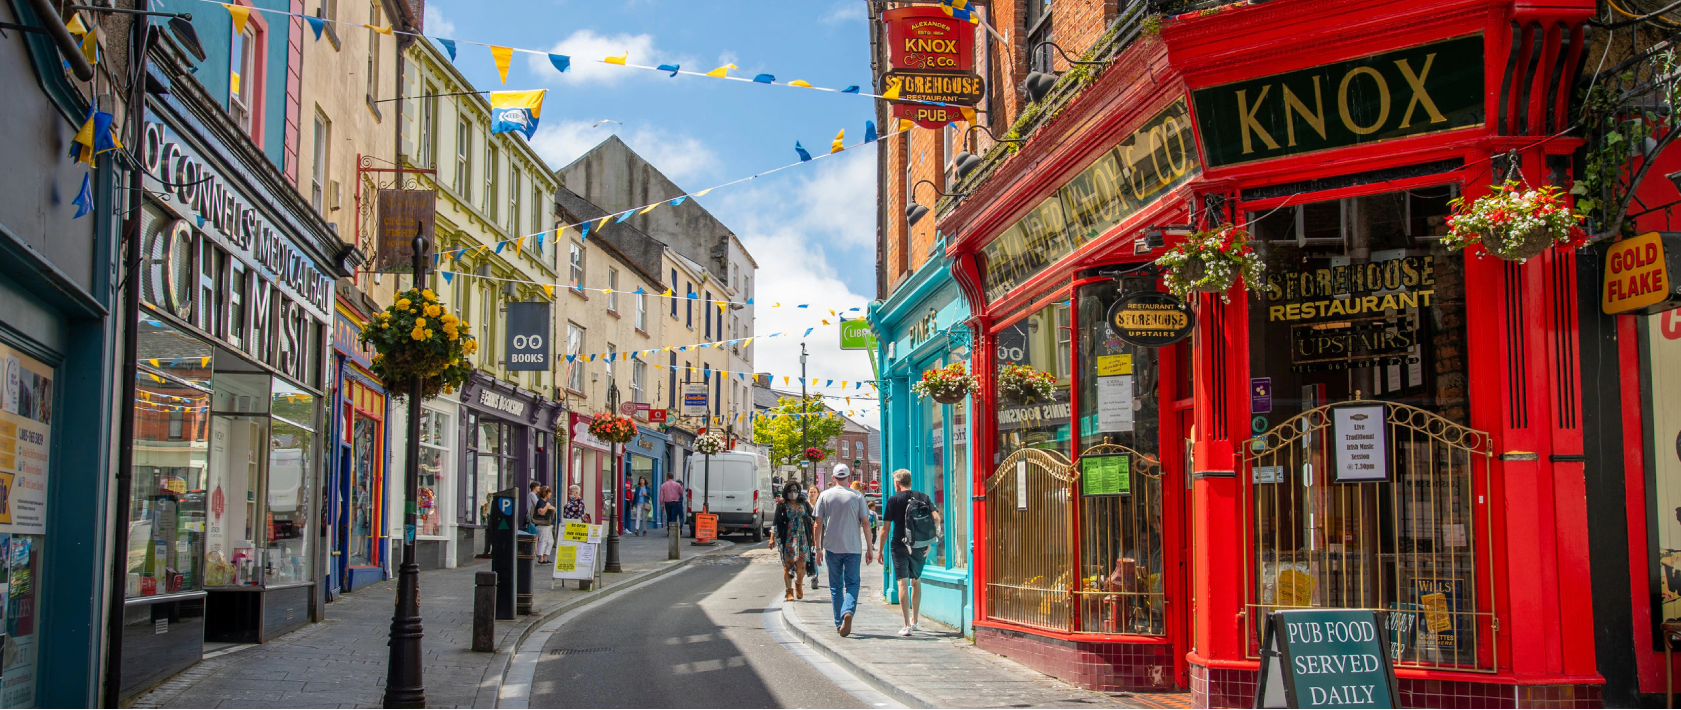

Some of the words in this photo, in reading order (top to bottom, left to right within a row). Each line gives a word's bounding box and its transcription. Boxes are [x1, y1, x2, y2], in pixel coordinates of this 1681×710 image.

[911, 21, 951, 32] ALEXANDER
[904, 38, 959, 54] KNOX
[926, 57, 936, 67] &
[937, 57, 957, 67] Co.
[885, 75, 980, 95] STOREHOUSE
[1235, 52, 1447, 154] KNOX
[917, 109, 947, 121] PUB
[383, 217, 415, 226] CYCLES
[987, 200, 1069, 288] ALEXANDER
[1067, 156, 1129, 235] KNOX
[385, 228, 426, 237] FISHIN
[254, 220, 308, 299] MEDICAL
[305, 267, 330, 315] HALL
[1610, 242, 1657, 274] GOLD
[1266, 255, 1435, 302] STOREHOUSE
[1608, 269, 1662, 303] FLAKE
[160, 219, 313, 384] CHEMIST
[1269, 290, 1435, 321] RESTAURANT
[1118, 314, 1184, 326] STOREHOUSE
[1298, 330, 1411, 357] UPSTAIRS
[511, 353, 544, 363] BOOKS
[1328, 363, 1348, 371] 065
[1345, 433, 1375, 441] Traditional
[1346, 443, 1359, 451] Irish
[502, 499, 511, 512] P
[1287, 622, 1323, 644] PUB
[1324, 621, 1375, 643] FOOD
[1295, 654, 1379, 675] SERVED
[1309, 685, 1375, 706] DAILY
